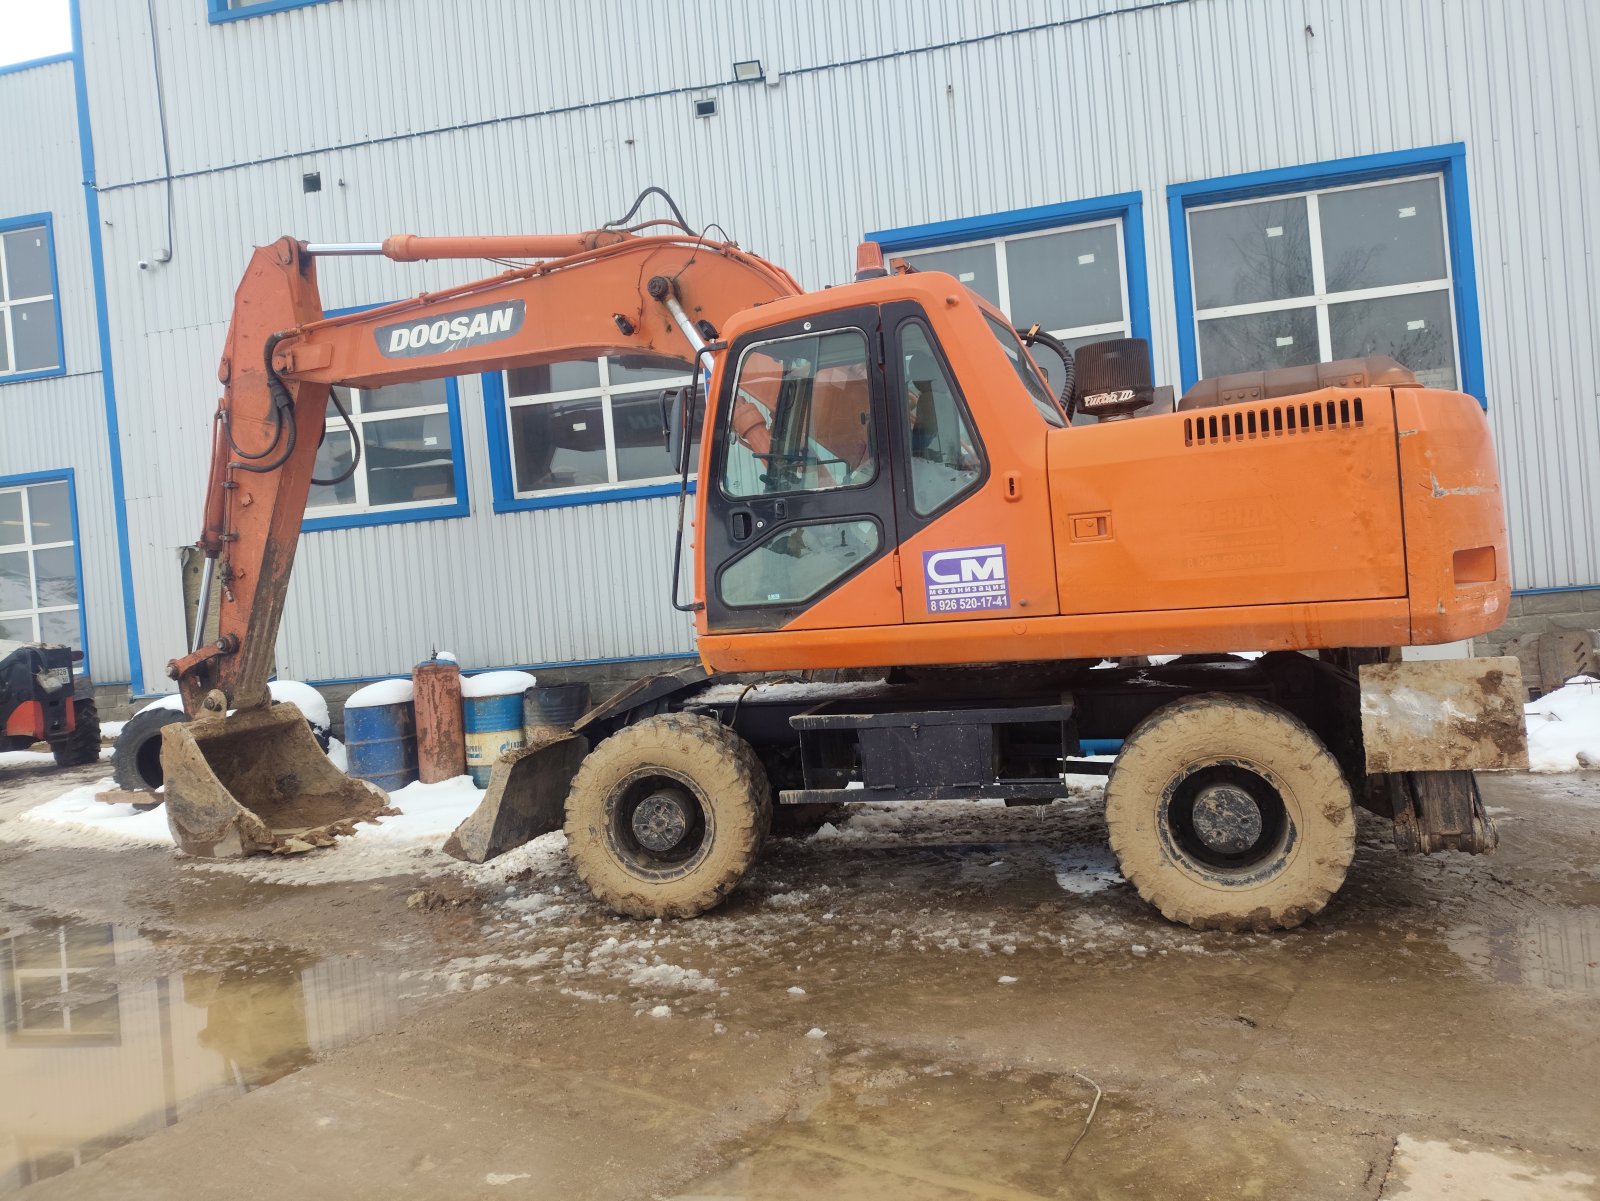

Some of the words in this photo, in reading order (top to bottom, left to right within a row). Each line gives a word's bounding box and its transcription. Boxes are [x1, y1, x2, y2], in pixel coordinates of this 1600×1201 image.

[389, 308, 513, 352] DOOSAN
[927, 547, 1005, 583] СМ
[929, 583, 1006, 595] механизация
[930, 600, 937, 611] 8
[939, 599, 957, 611] 926
[959, 595, 1008, 610] 520-17-41
